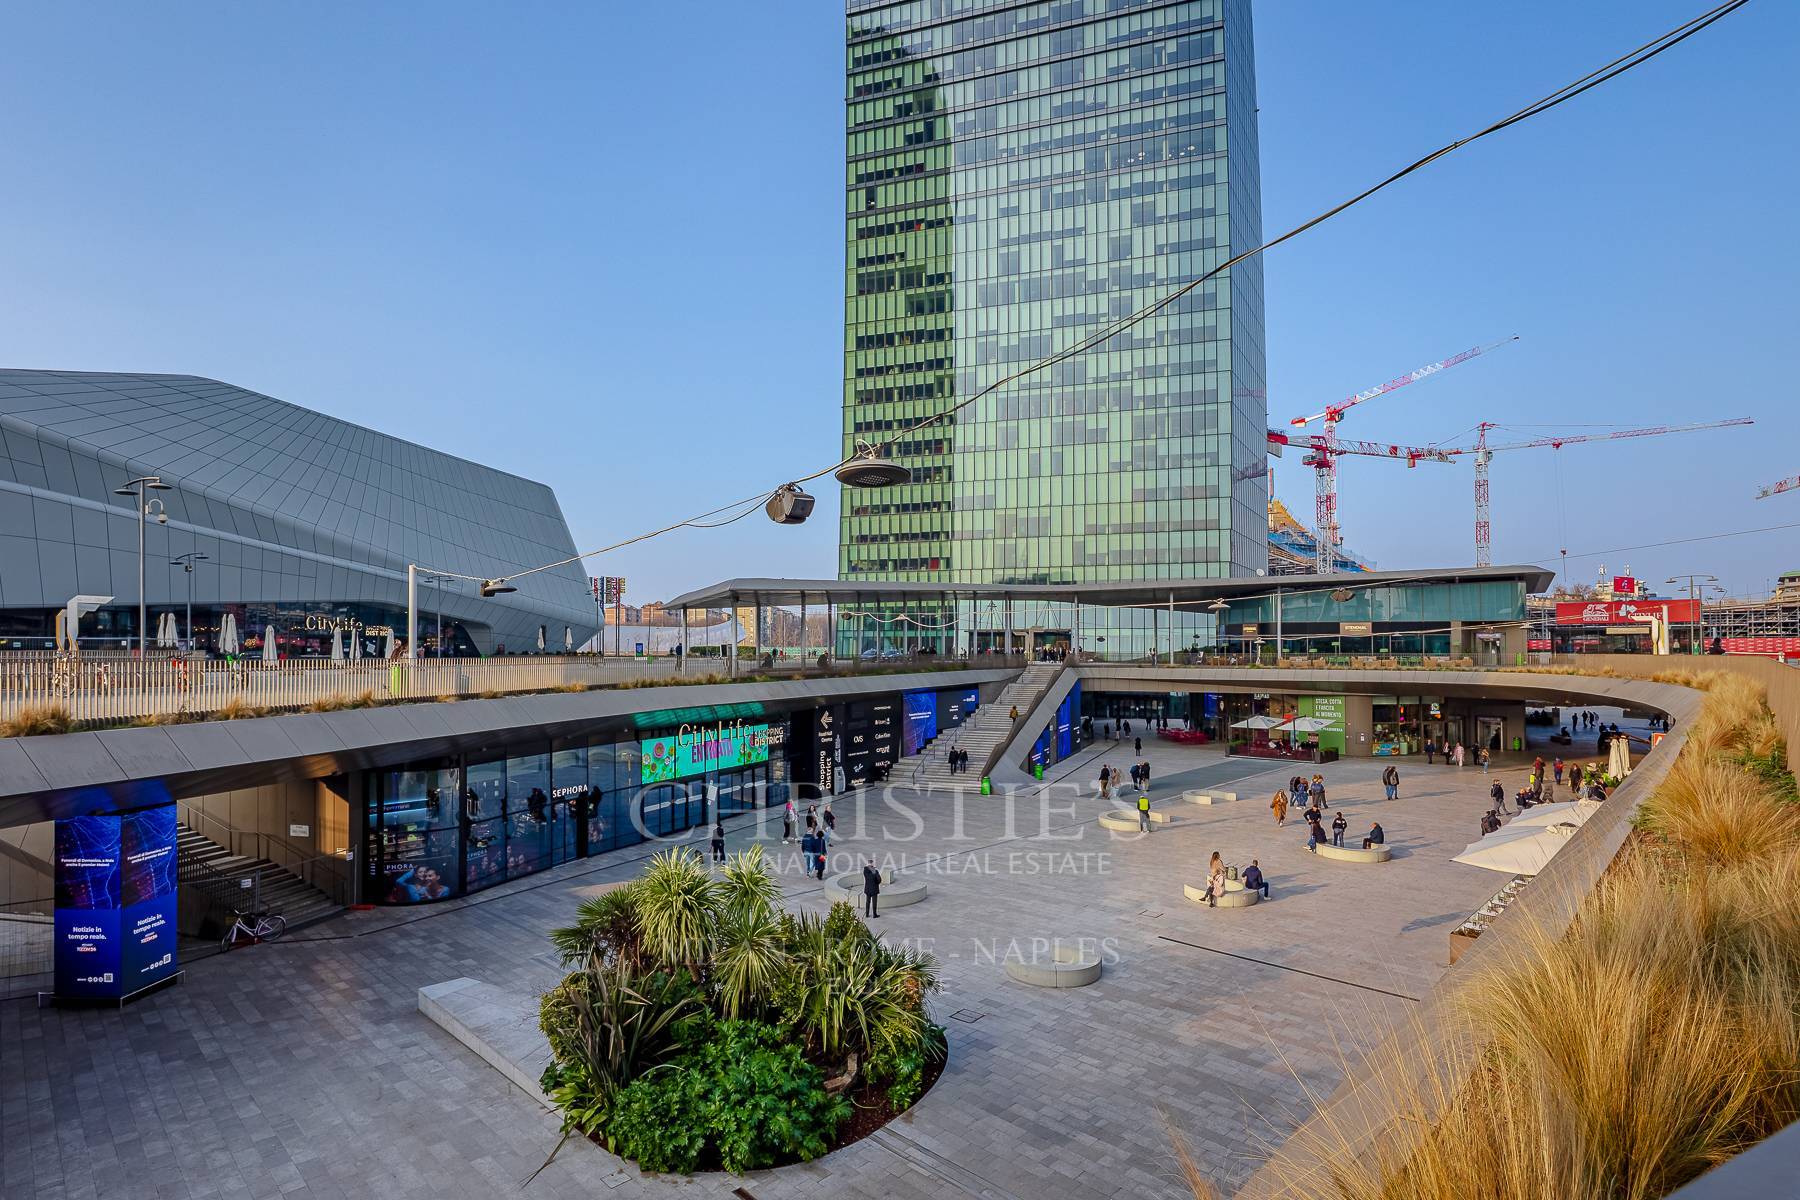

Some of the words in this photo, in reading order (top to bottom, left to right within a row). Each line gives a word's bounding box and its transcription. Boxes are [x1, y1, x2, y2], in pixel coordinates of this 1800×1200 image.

[305, 615, 363, 634] CityLife
[678, 718, 751, 748] CityLife
[755, 727, 784, 737] SHOPPING
[853, 735, 864, 743] OVS
[755, 735, 784, 746] DISTRICT
[692, 739, 733, 763] ENTRATA
[552, 784, 588, 798] SEPHORA
[133, 925, 151, 935] tempo
[151, 919, 166, 928] reale.
[137, 915, 157, 926] Notizie
